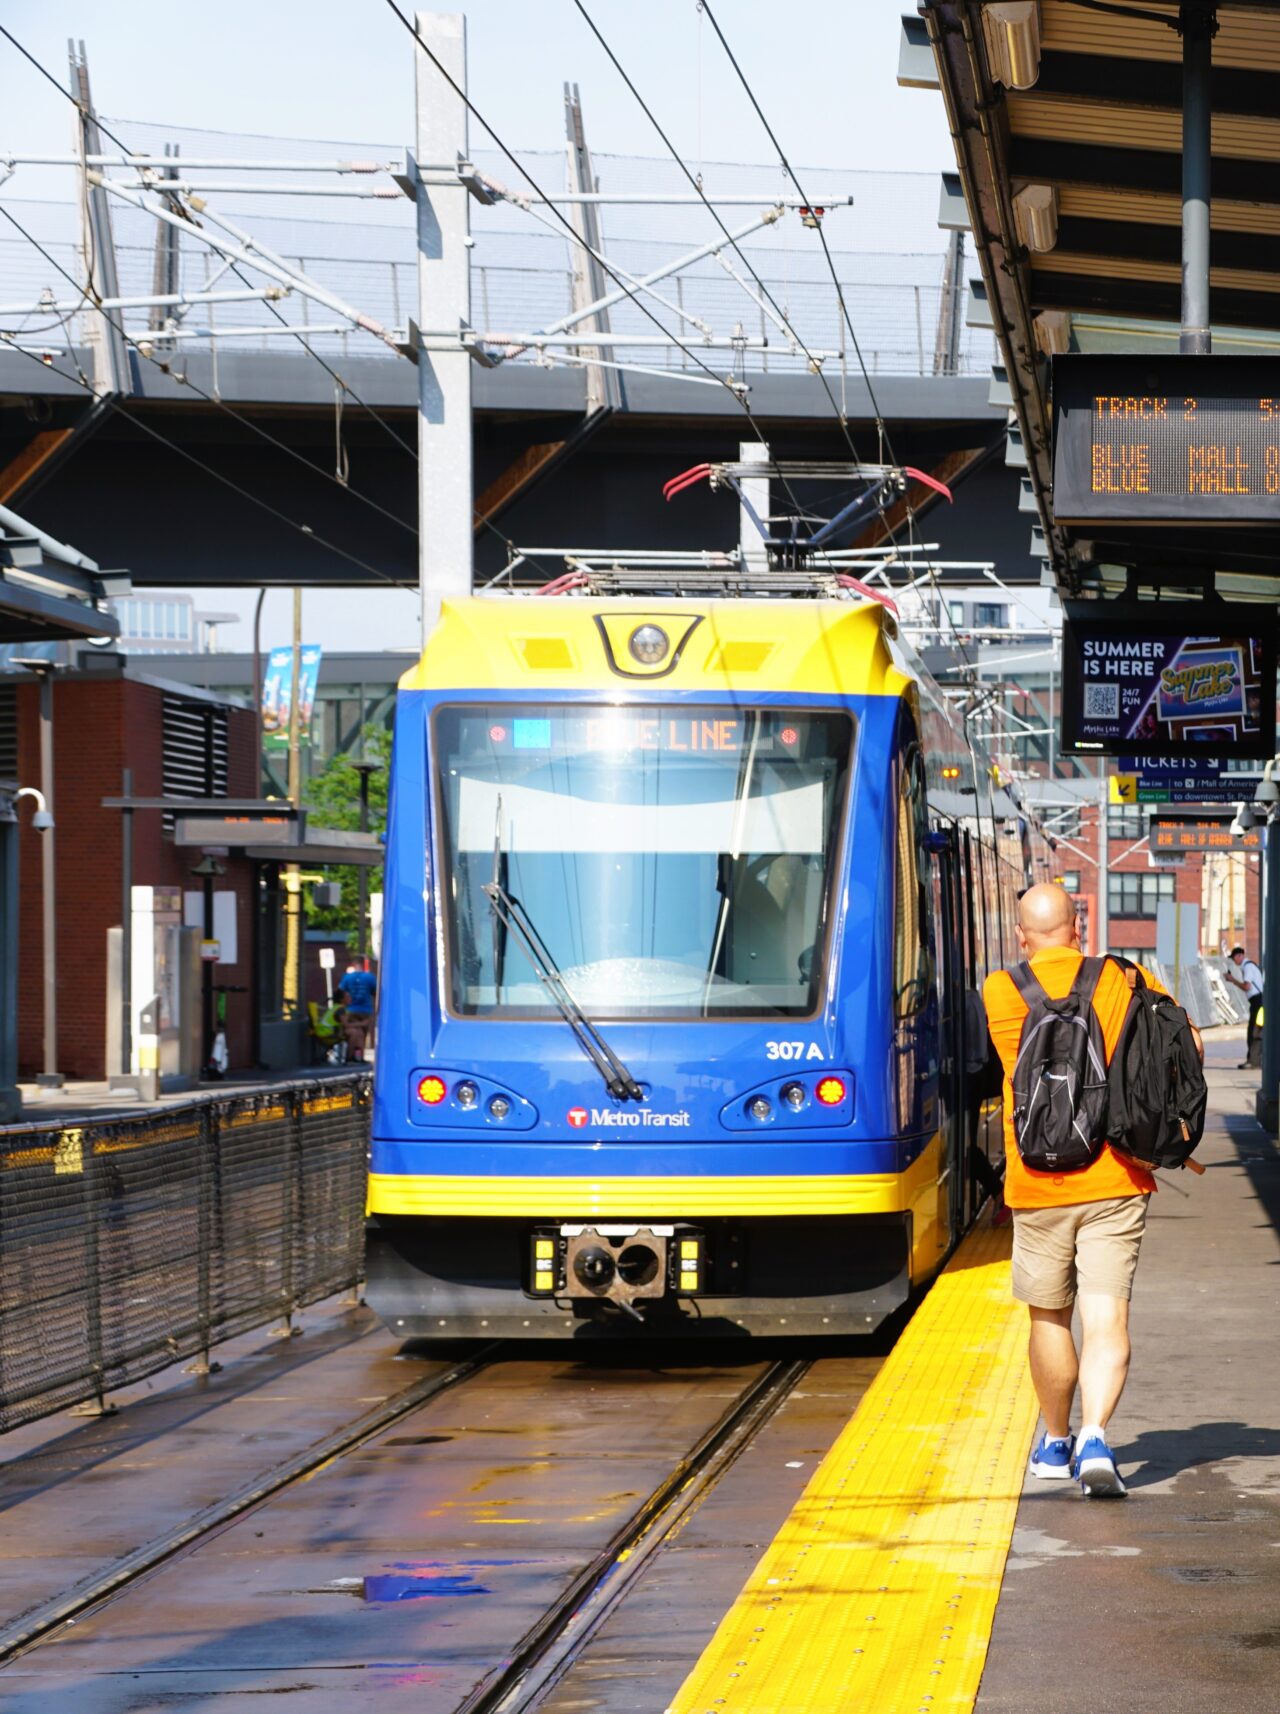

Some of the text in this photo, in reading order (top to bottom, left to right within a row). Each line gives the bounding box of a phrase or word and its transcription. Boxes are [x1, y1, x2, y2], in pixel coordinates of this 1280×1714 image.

[1095, 397, 1168, 419] TRACK
[1184, 398, 1197, 420] 2
[1092, 443, 1149, 467] BLUE
[1189, 445, 1249, 468] MALL
[1092, 468, 1149, 492] BLUE
[1189, 470, 1249, 493] MALL
[1083, 641, 1165, 657] SUMMER
[1084, 660, 1155, 676] IS HERE
[1122, 688, 1140, 697] 24/7
[1122, 697, 1141, 705] FUN
[669, 719, 738, 750] LINE
[1174, 780, 1183, 788] to
[1201, 779, 1217, 787] Mall
[1218, 779, 1228, 787] of
[1185, 792, 1225, 800] downtown
[765, 1041, 824, 1062] 307A
